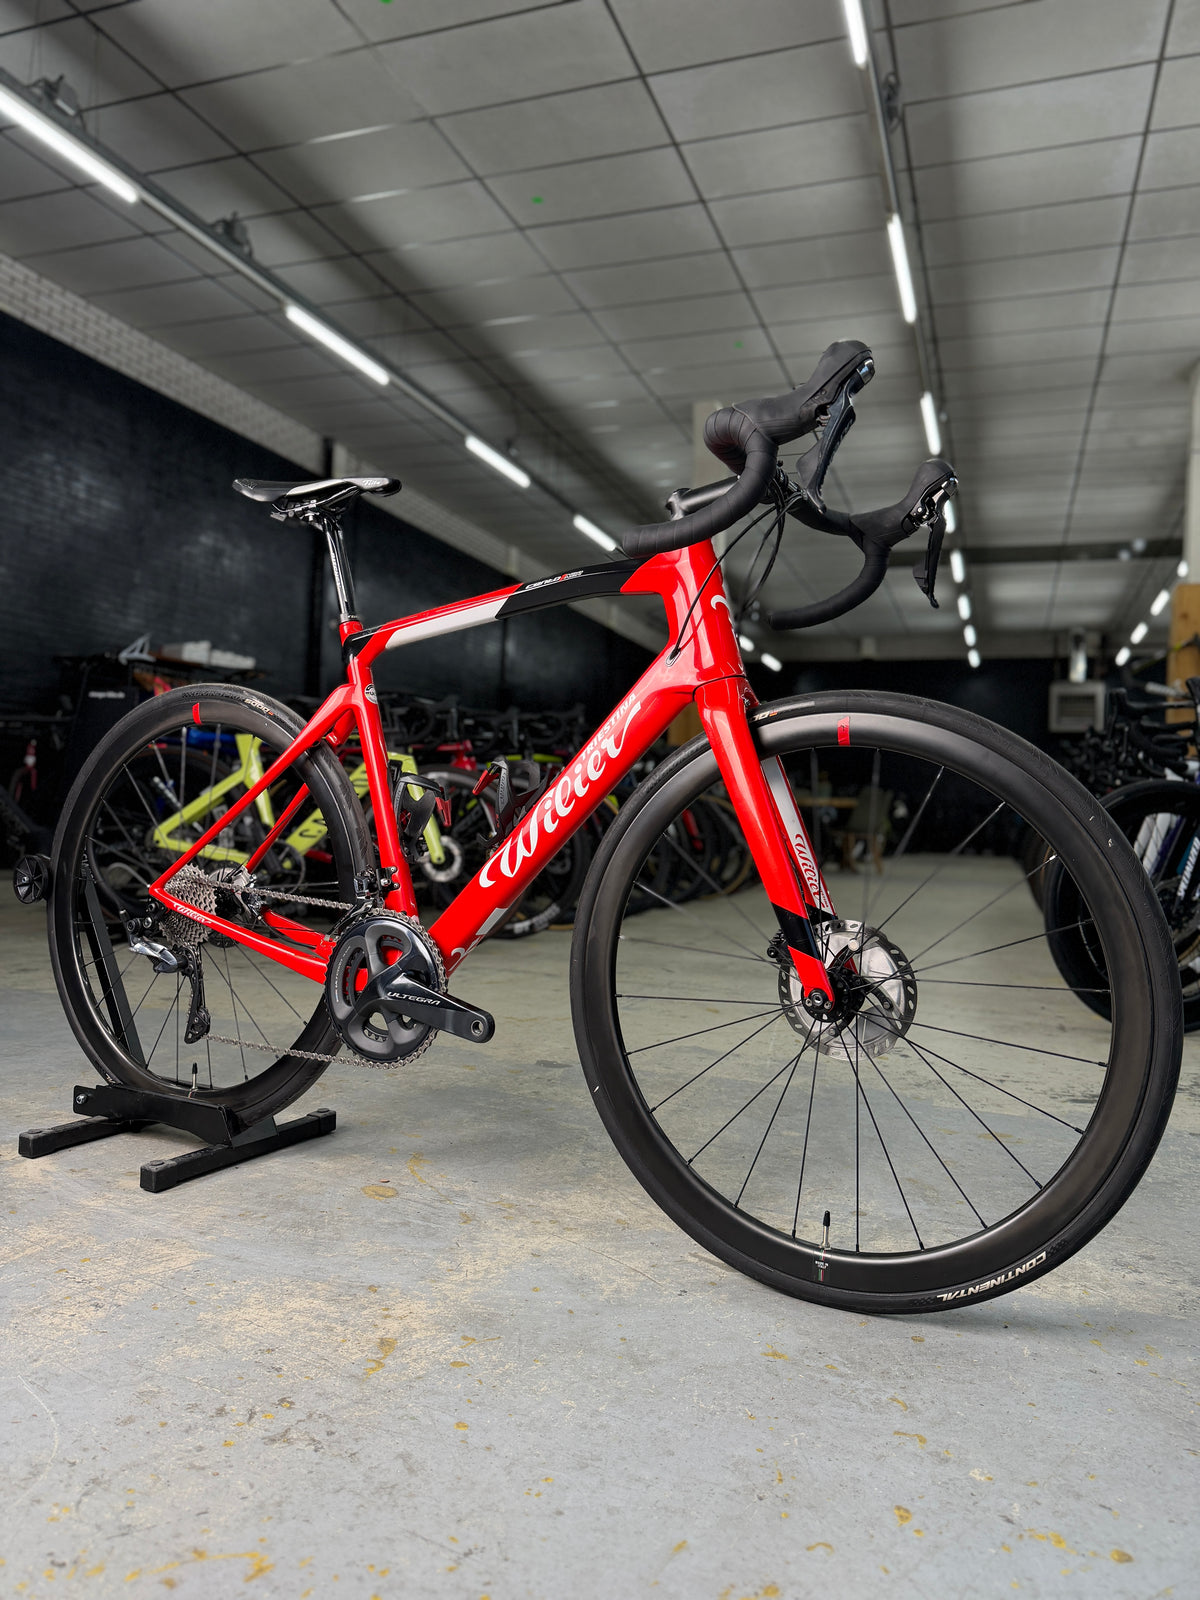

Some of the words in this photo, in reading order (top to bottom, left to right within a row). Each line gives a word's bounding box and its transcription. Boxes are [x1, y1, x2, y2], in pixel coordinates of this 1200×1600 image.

[580, 693, 636, 760] TRIESTINA
[479, 701, 641, 888] Wilier
[387, 991, 440, 1005] ULTEGRA
[937, 1251, 1048, 1302] CONTINENTAL
